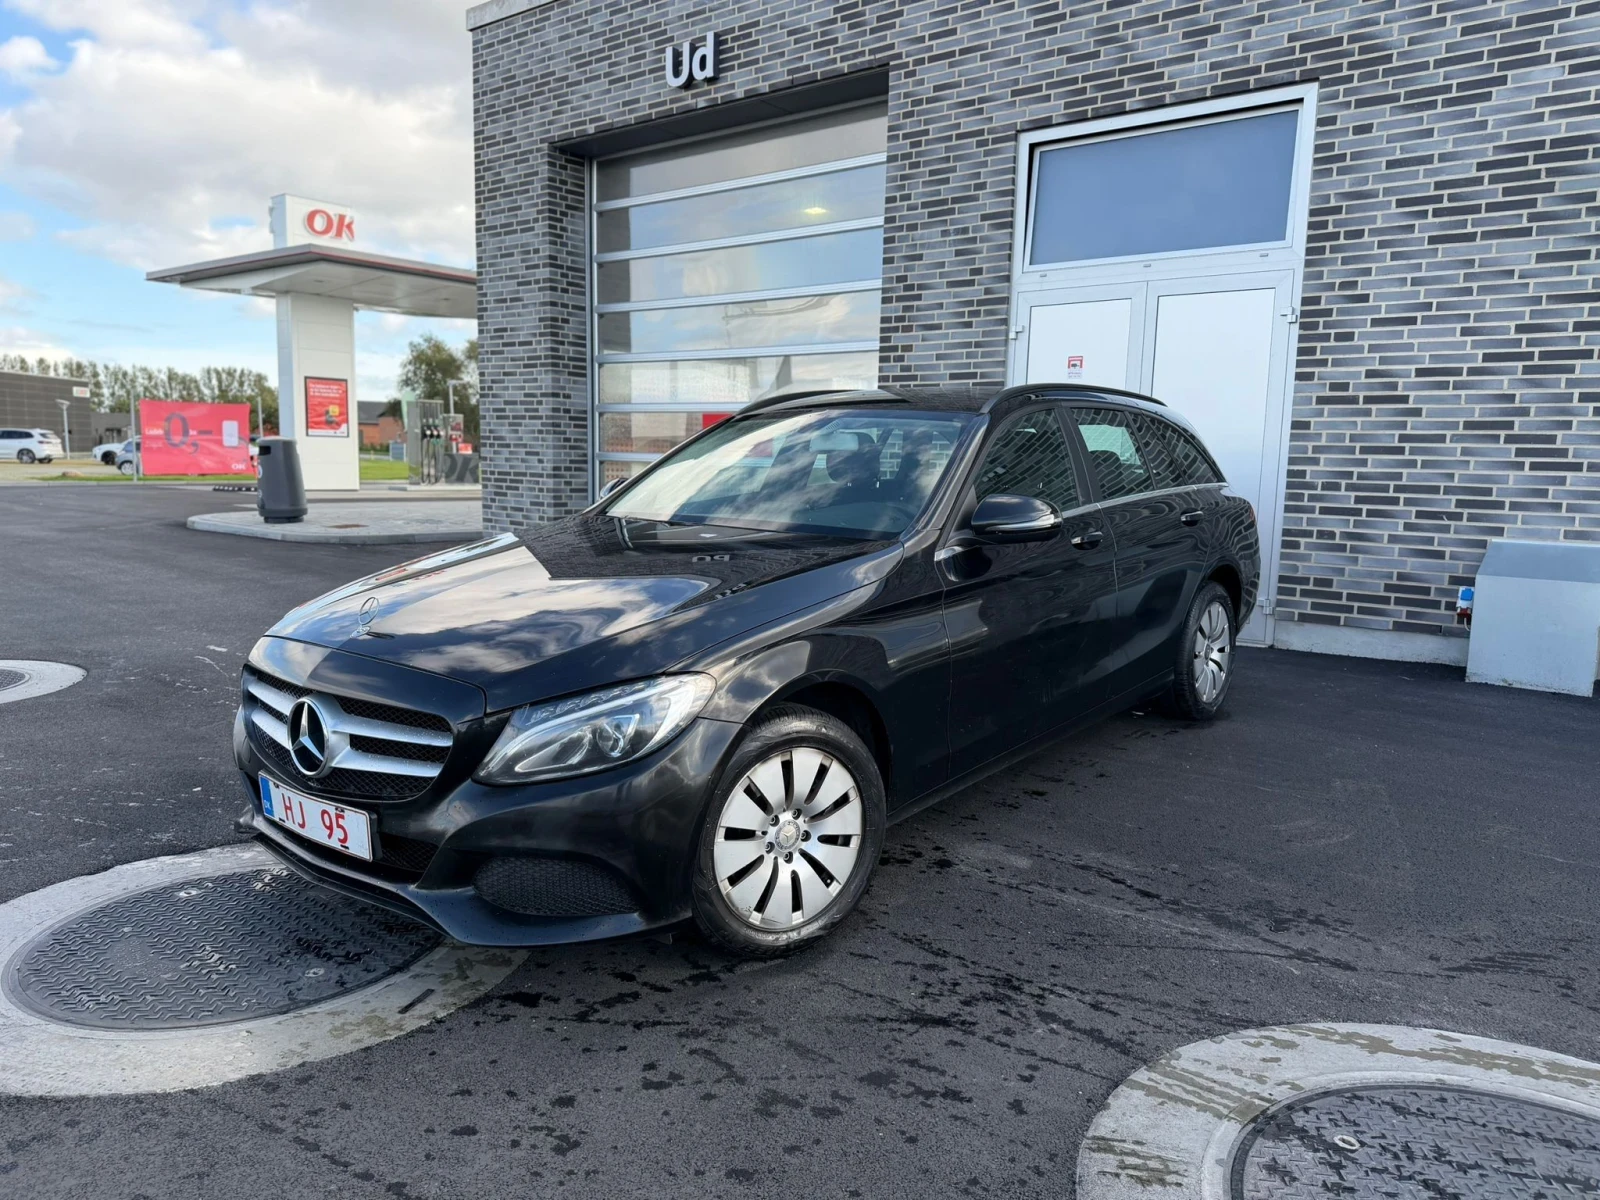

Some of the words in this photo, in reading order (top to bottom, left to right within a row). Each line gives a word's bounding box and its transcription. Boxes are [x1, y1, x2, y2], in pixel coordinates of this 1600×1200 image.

[665, 31, 714, 87] Ud
[306, 209, 354, 239] OK
[281, 792, 306, 829] HJ
[320, 809, 349, 844] 95
